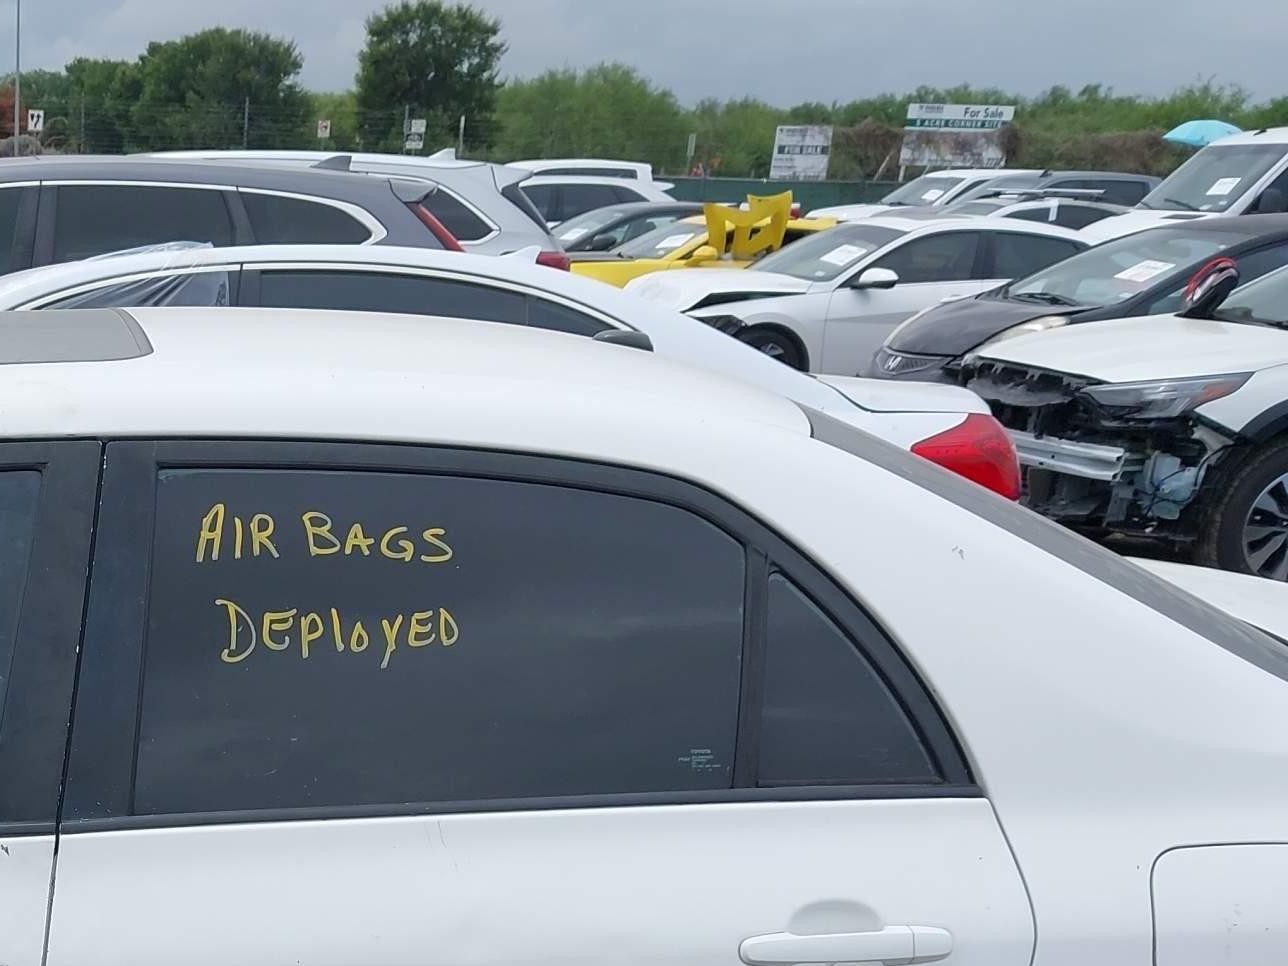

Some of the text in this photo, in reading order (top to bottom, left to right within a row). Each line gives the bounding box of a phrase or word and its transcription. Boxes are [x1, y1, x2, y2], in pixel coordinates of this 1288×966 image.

[964, 107, 1004, 119] For Sale
[923, 119, 945, 129] ACRE
[948, 119, 983, 129] CORNER
[195, 503, 453, 563] AIR BAGS
